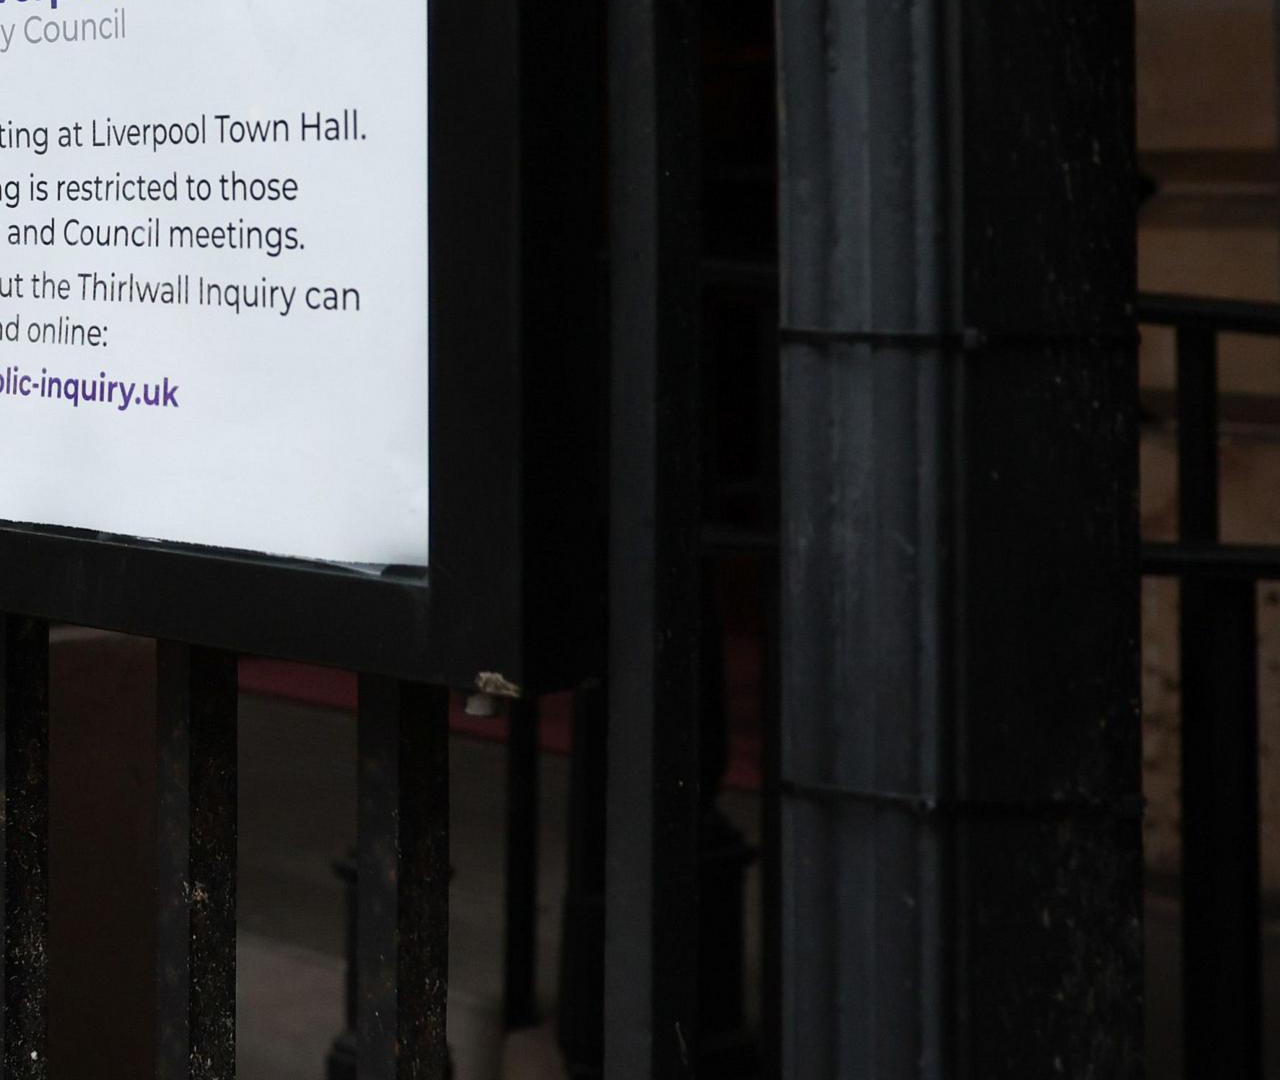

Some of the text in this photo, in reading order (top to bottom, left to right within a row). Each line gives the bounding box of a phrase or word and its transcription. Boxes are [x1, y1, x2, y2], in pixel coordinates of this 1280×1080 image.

[23, 7, 126, 45] Council
[57, 121, 84, 149] at
[91, 113, 206, 154] Liverpool
[213, 114, 290, 144] Town
[300, 107, 367, 142] Hall.
[29, 171, 49, 202] is
[56, 170, 178, 202] restricted
[185, 174, 213, 202] to
[218, 169, 299, 202] those
[7, 216, 56, 247] and
[63, 216, 160, 248] Council
[169, 217, 305, 259] meetings.
[29, 269, 72, 301] the
[76, 271, 189, 305] Thirlwall
[199, 275, 297, 317] Inquiry
[304, 286, 361, 312] can
[26, 315, 109, 348] online:
